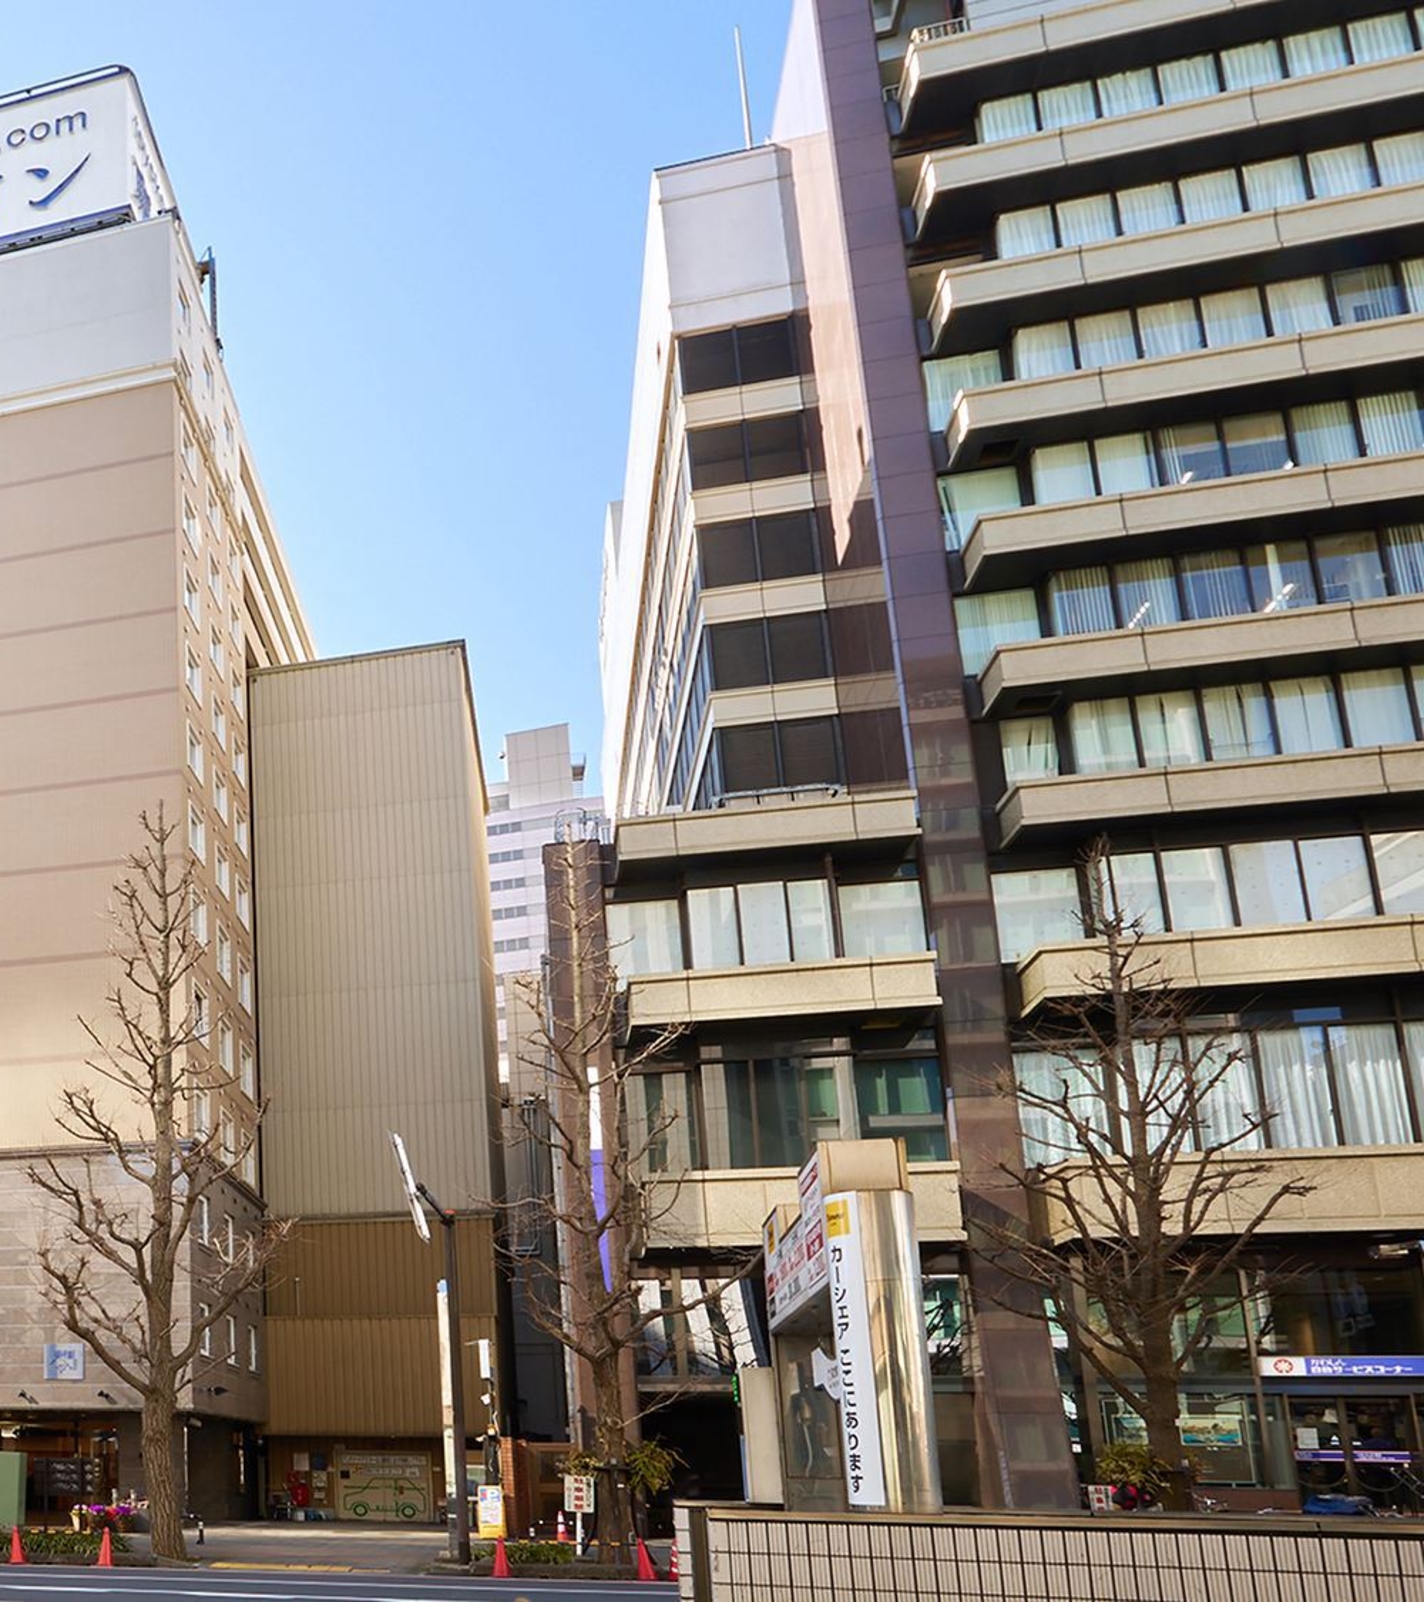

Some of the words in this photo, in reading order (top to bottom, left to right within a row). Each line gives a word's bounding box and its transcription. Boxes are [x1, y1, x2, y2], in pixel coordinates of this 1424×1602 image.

[831, 1245, 849, 1340] カーシェア
[841, 1349, 863, 1493] ここにあります
